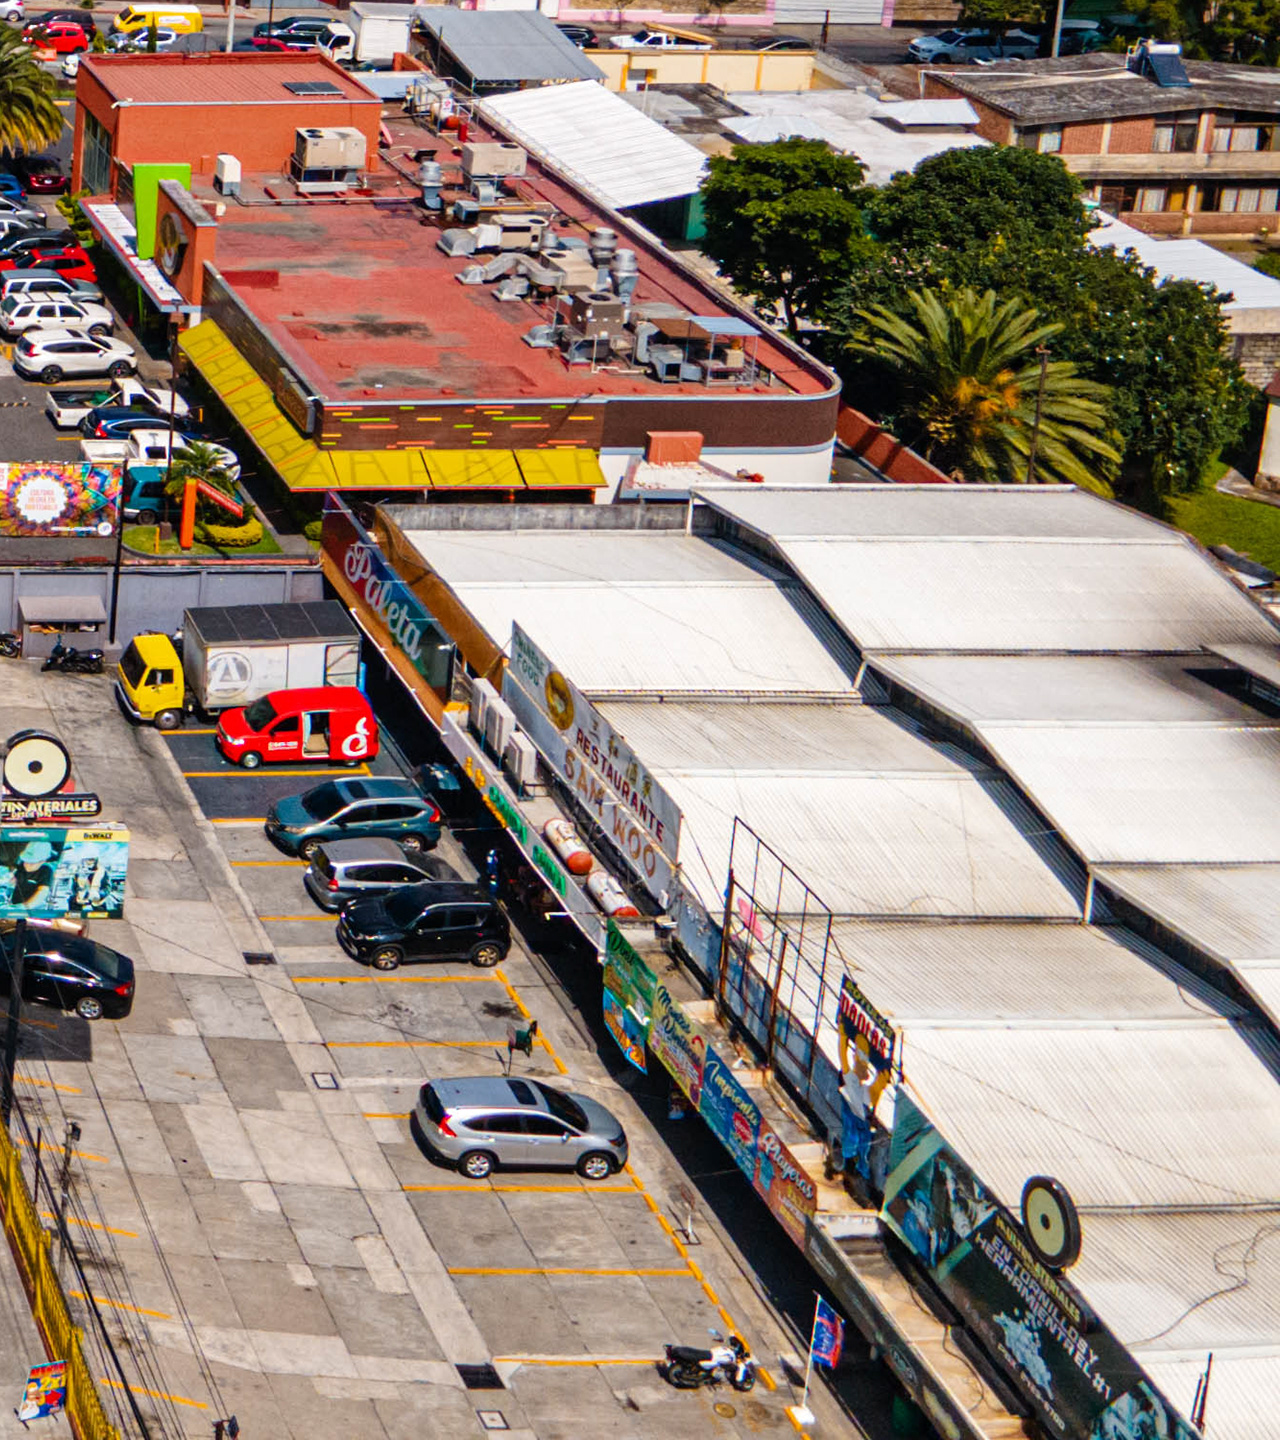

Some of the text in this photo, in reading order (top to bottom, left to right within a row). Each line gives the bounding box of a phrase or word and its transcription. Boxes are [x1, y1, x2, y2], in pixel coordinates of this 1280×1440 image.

[344, 541, 422, 661] Paleta
[576, 727, 665, 843] RESTAURANTE
[612, 803, 657, 879] WOO
[974, 1232, 1075, 1356] HERRAMIENTA
[1074, 1351, 1092, 1379] EL
[992, 1234, 1013, 1265] EN
